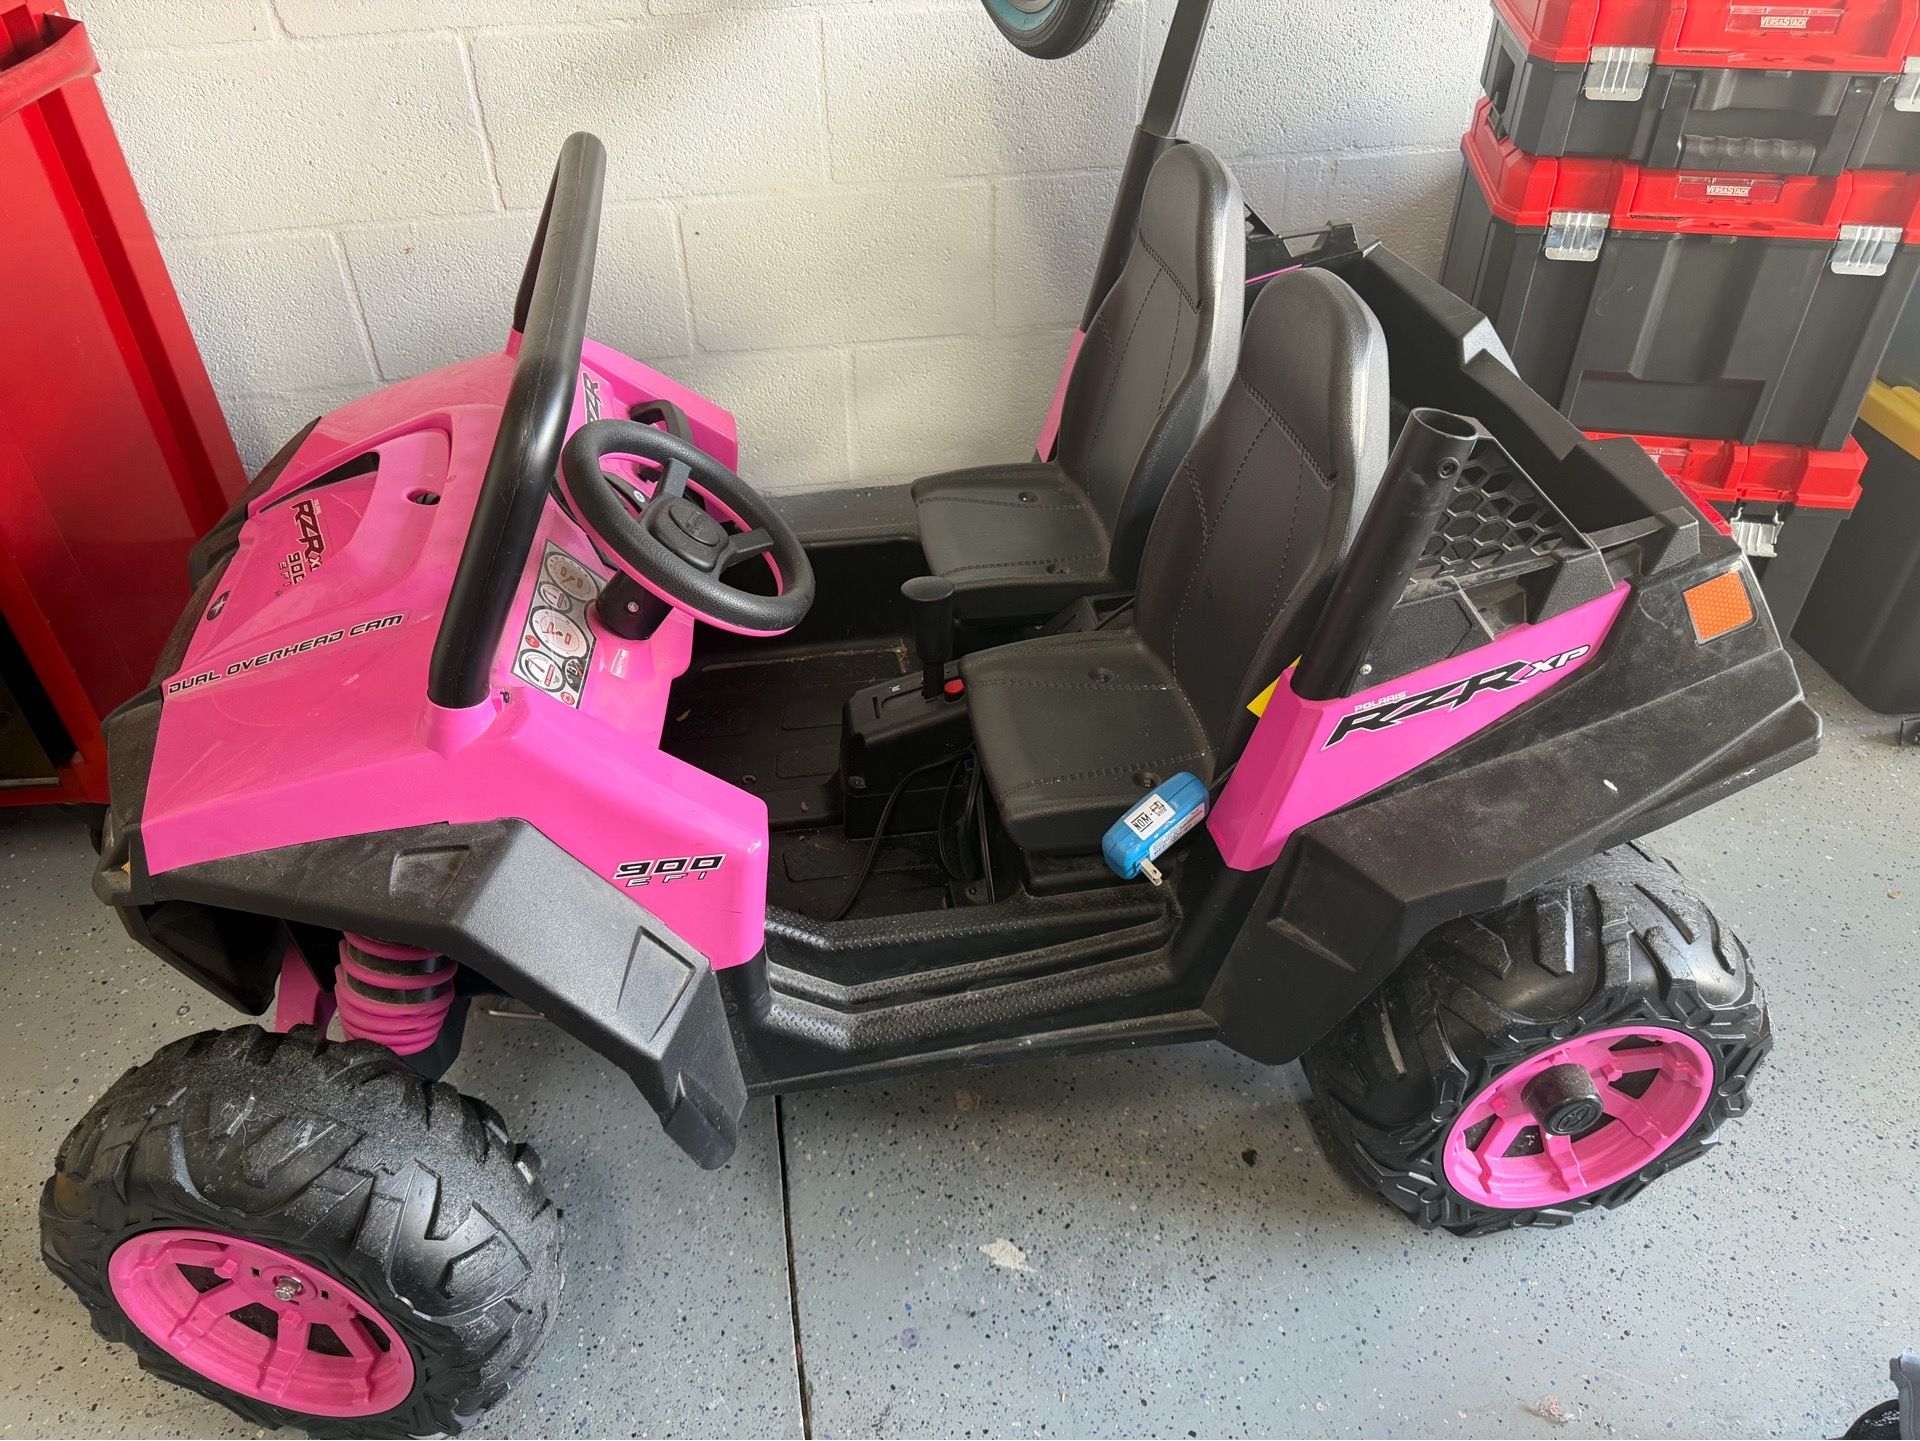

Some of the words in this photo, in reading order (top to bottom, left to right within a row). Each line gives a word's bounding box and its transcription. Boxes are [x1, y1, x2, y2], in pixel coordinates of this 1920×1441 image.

[290, 499, 326, 562] RZR
[169, 670, 221, 694] DUAL
[227, 629, 344, 676] OVERHEAD
[349, 614, 403, 637] CAM
[1321, 659, 1534, 751] RZR
[1522, 644, 1591, 679] XP
[1354, 690, 1408, 713] POLARIS
[1132, 812, 1153, 831] NOM
[613, 854, 726, 879] 900
[626, 871, 707, 887] EFI
